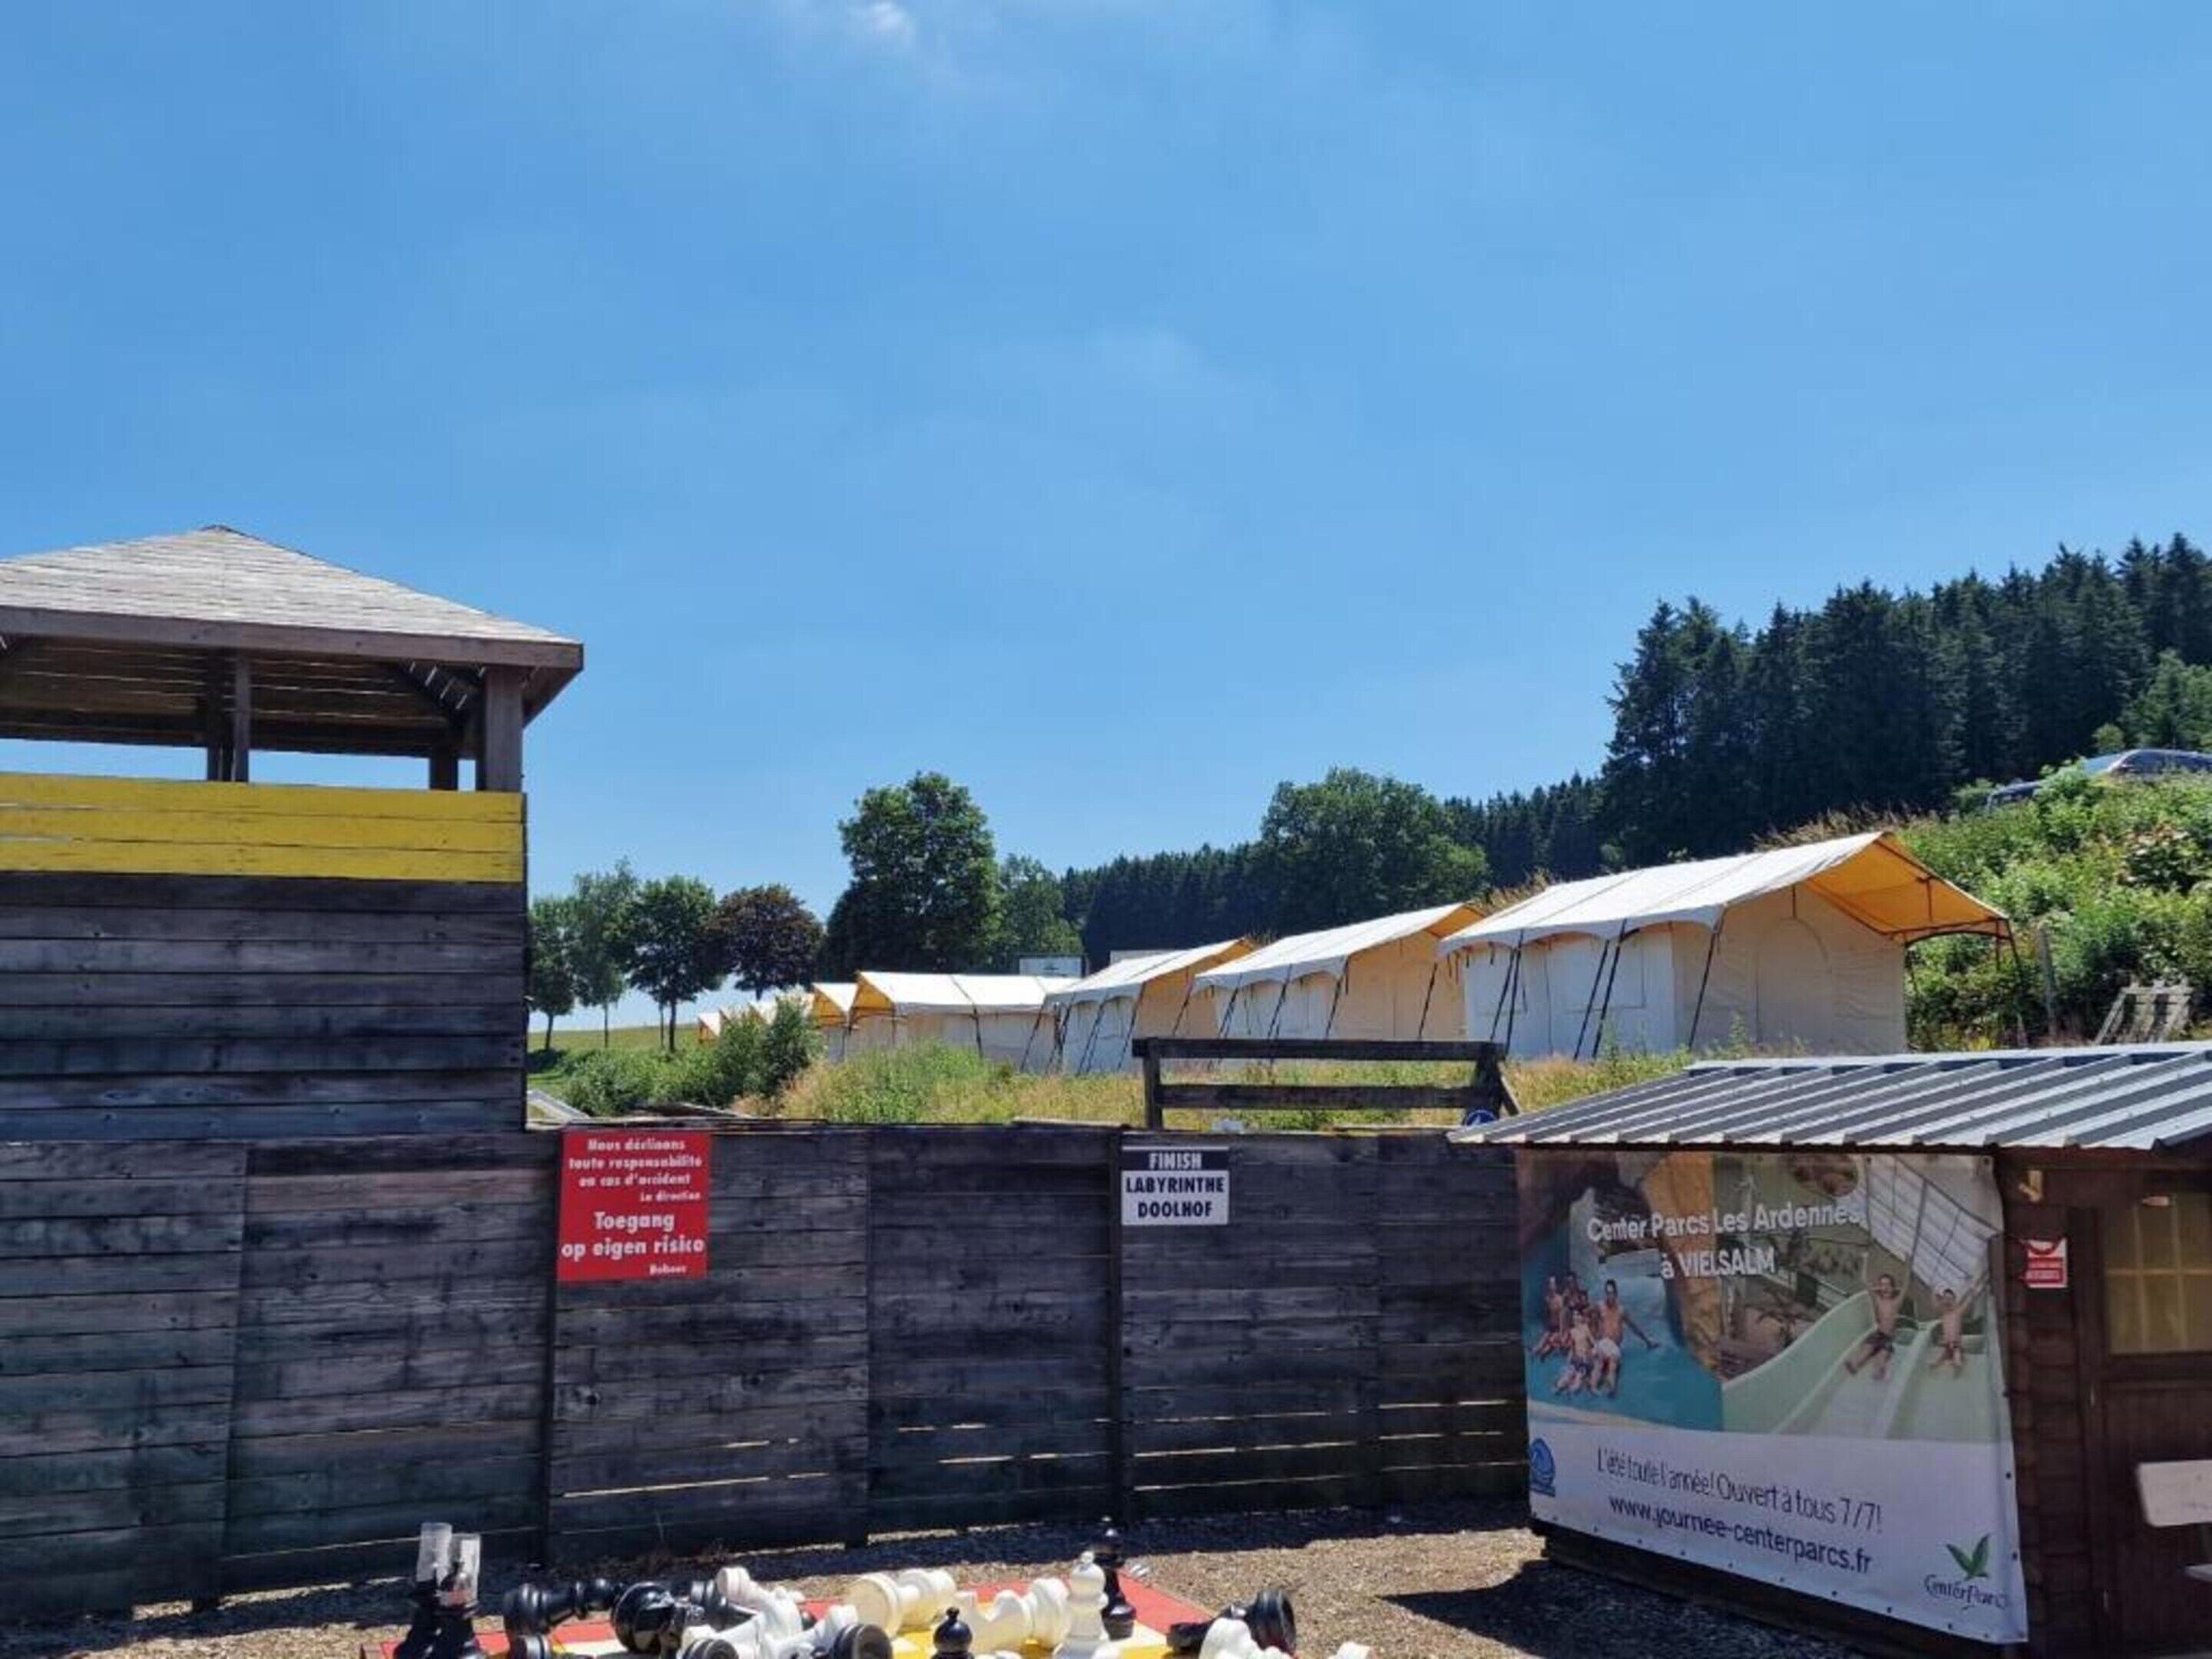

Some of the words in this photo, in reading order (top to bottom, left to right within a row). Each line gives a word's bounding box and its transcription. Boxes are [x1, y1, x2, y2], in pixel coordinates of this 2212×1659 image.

[588, 1138, 621, 1151] Nous
[568, 1157, 604, 1170] toute
[609, 1154, 702, 1171] responsabilité
[1149, 1153, 1202, 1169] FINISH
[579, 1177, 596, 1187] en
[600, 1176, 621, 1187] cas
[624, 1173, 690, 1186] d'accident
[1126, 1177, 1224, 1193] LABYRINTHE
[1137, 1200, 1212, 1217] DOOLHOF
[594, 1211, 675, 1234] Toegang
[1588, 1215, 1647, 1242] Center
[1651, 1211, 1710, 1238] Parcs
[1713, 1207, 1748, 1232] Les
[561, 1243, 586, 1262] op
[592, 1237, 647, 1260] eigen
[654, 1234, 705, 1254] risico
[1661, 1253, 1675, 1280] à
[1677, 1247, 1777, 1277] VIELSALM
[1598, 1445, 1625, 1479] L'été
[1628, 1455, 1659, 1486] toute
[1717, 1472, 1777, 1510] Ouvert
[1781, 1485, 1792, 1512] à
[1796, 1489, 1836, 1524] tous
[1609, 1495, 1873, 1573] www.journee-centerparcs.fr
